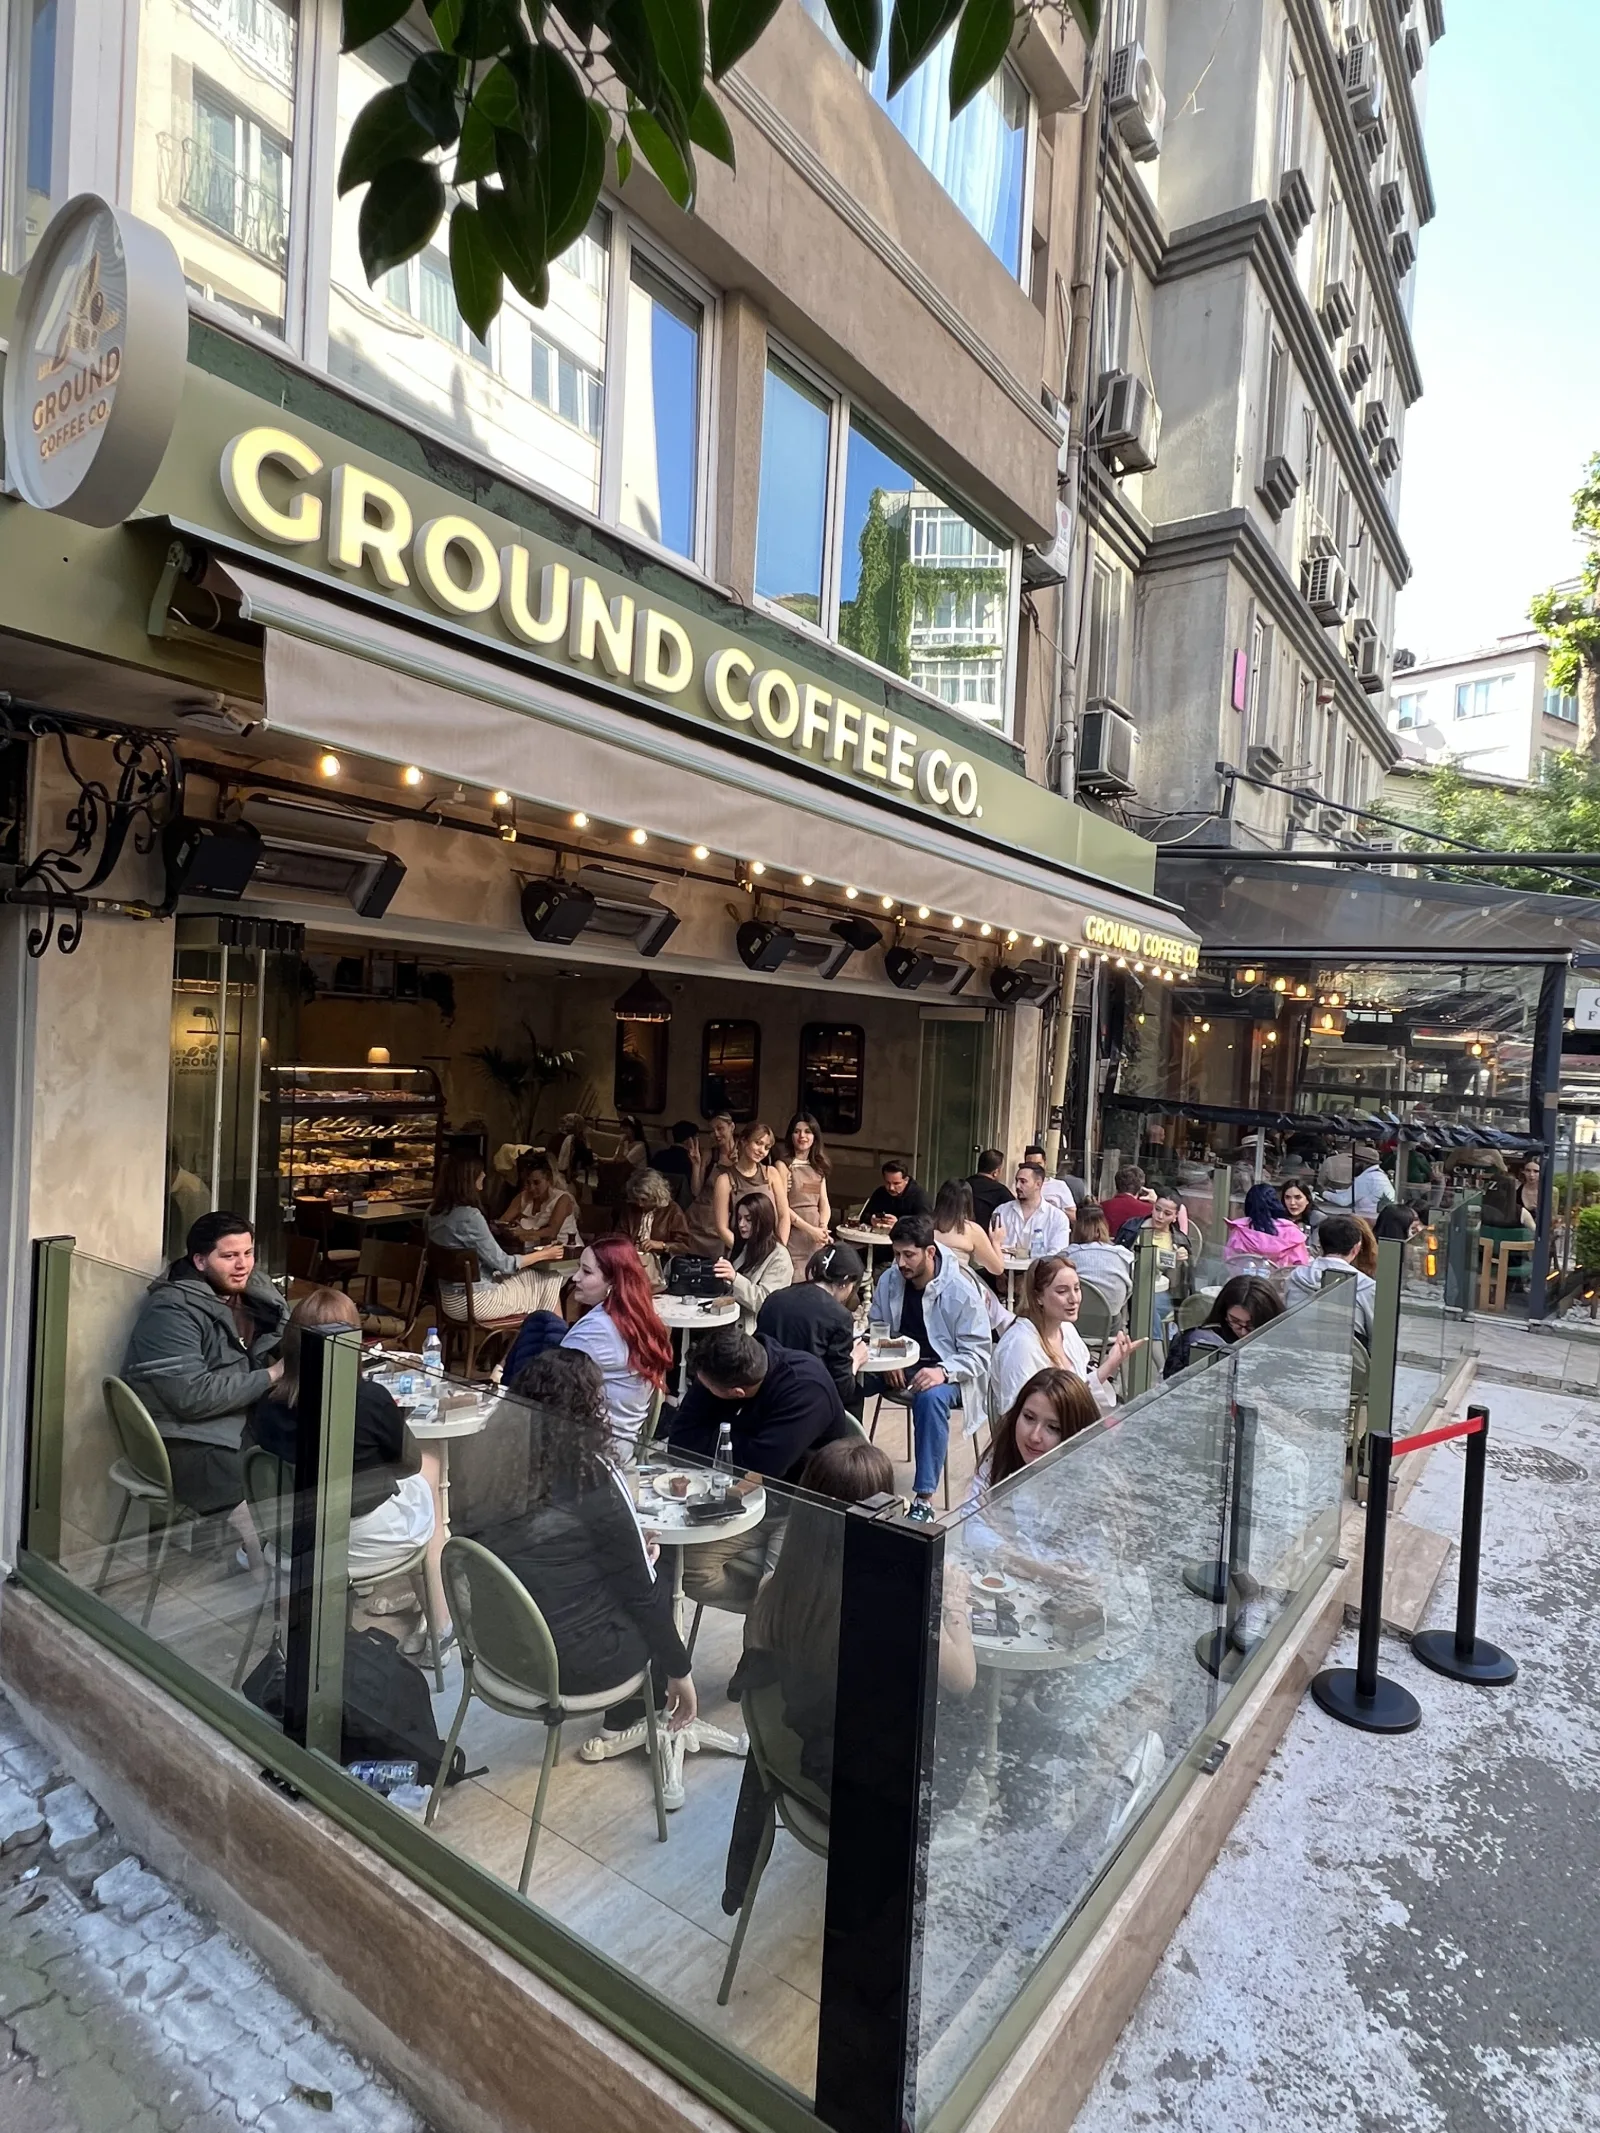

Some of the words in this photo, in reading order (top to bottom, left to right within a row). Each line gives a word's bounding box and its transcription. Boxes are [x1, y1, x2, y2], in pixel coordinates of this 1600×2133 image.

[32, 346, 121, 432] GROUND
[39, 412, 87, 458] COFFEE
[87, 399, 111, 426] CO.
[220, 426, 695, 694] GROUND
[704, 648, 918, 791] COFFEE
[917, 748, 983, 818] CO.
[1085, 915, 1140, 952] GROUND
[1143, 933, 1183, 963] COFFEE
[1183, 944, 1199, 969] CO.
